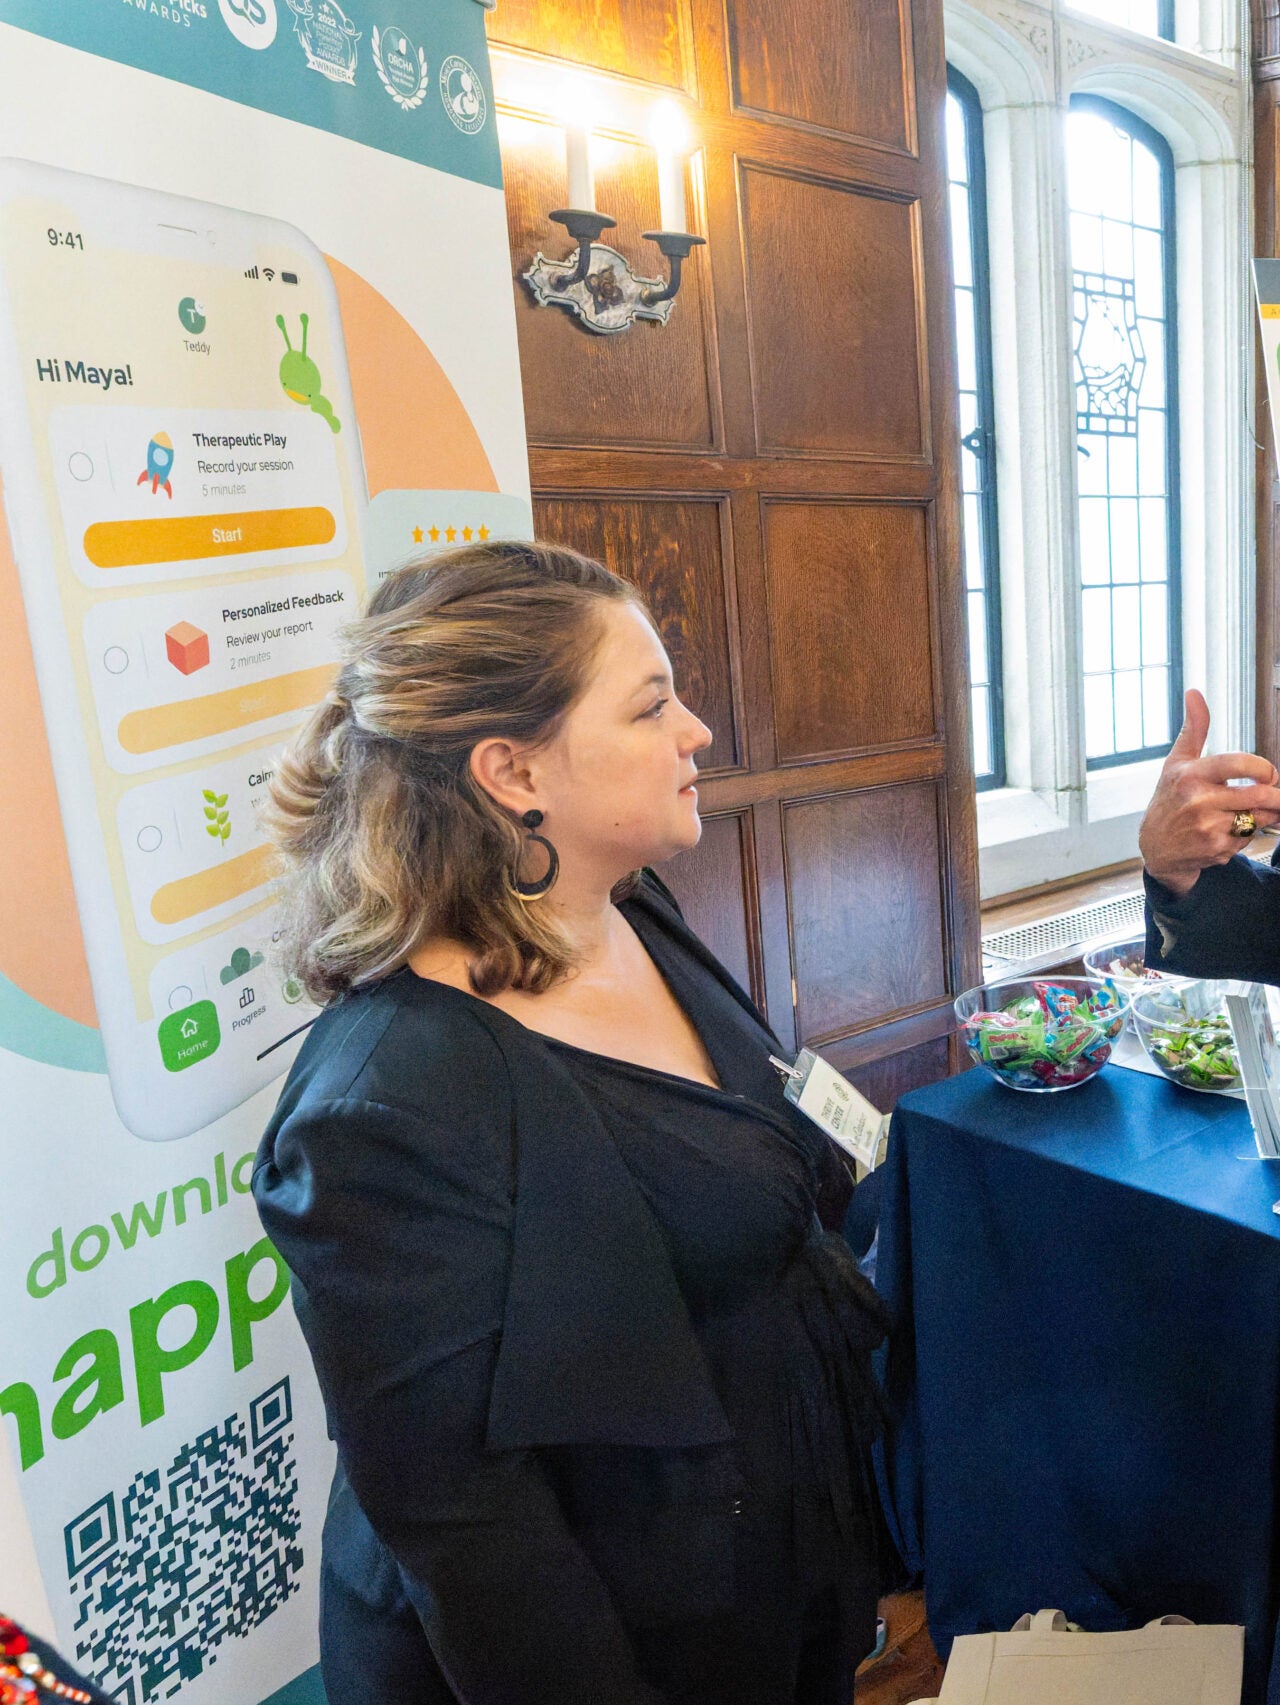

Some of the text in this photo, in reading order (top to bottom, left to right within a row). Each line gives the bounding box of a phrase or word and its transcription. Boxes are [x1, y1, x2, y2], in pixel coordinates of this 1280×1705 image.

[317, 12, 337, 28] 2022
[315, 60, 348, 80] WINNER
[388, 52, 415, 74] ORCHA
[47, 228, 84, 250] 9:41
[183, 340, 211, 355] Teddy
[36, 358, 134, 391] Hi Maya!
[192, 433, 287, 450] Therapeutic Play
[197, 458, 294, 476] Record your session
[201, 483, 247, 497] 5 minutes
[212, 527, 243, 544] Start
[222, 590, 345, 623] Personalized Feedback
[226, 620, 314, 649] Review your report
[230, 651, 272, 670] 2 minutes
[231, 1005, 267, 1032] Progress
[177, 1039, 210, 1061] Home
[830, 1105, 845, 1130] CENTER
